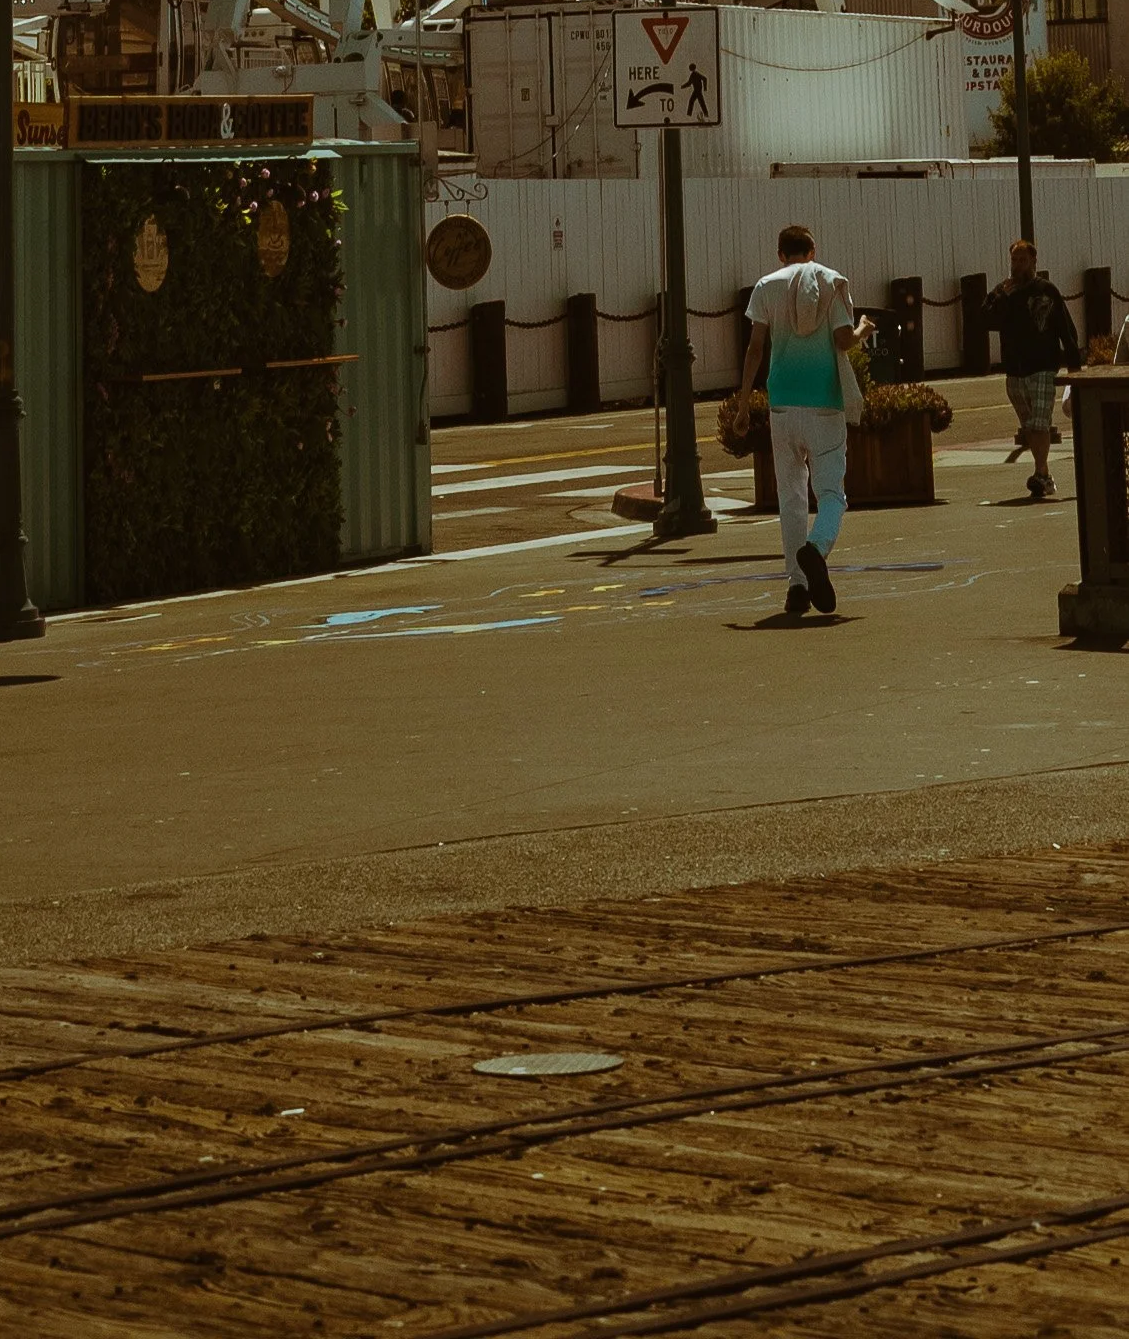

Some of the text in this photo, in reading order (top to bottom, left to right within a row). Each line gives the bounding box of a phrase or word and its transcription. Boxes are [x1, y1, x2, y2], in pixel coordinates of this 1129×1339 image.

[628, 66, 660, 81] HERE
[972, 68, 980, 78] &
[659, 98, 675, 112] TO
[167, 103, 221, 140] BOBA
[220, 102, 235, 139] &
[234, 102, 309, 138] COFFEE
